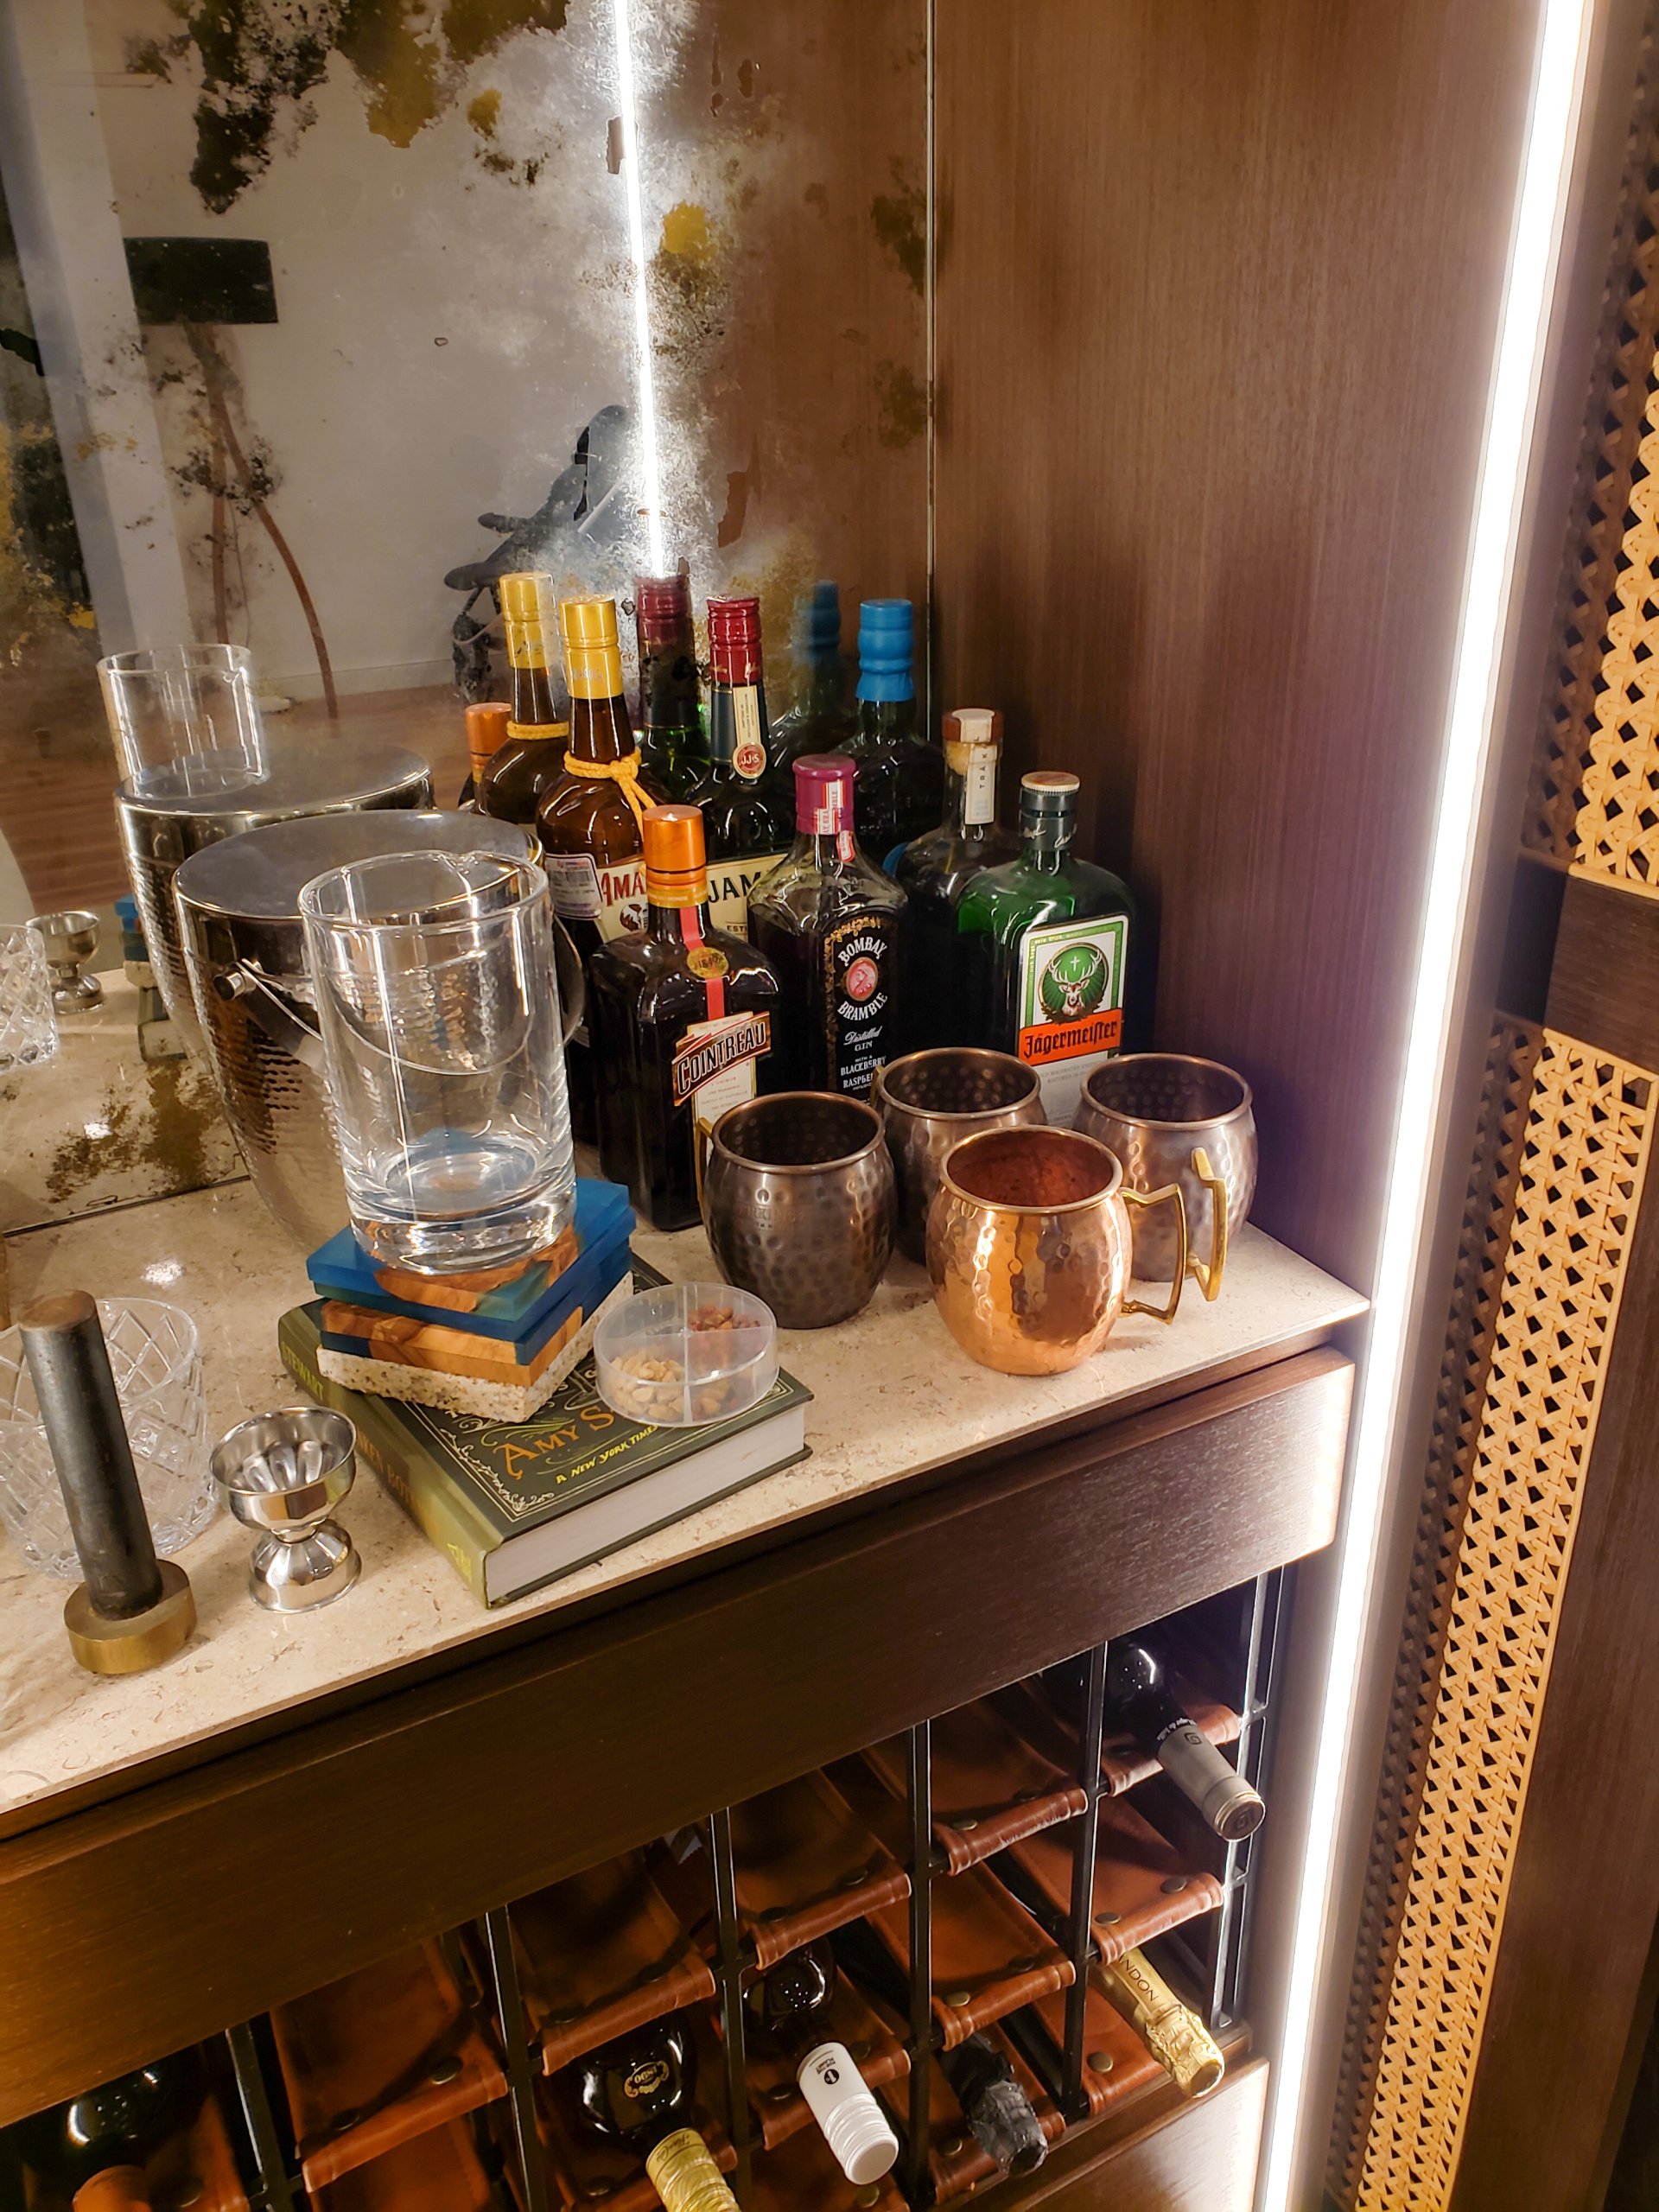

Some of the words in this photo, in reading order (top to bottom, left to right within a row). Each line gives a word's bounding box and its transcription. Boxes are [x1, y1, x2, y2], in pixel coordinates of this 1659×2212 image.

[837, 937, 887, 967] BOMBAY
[837, 992, 888, 1020] BRAMBLE
[677, 1021, 766, 1096] COINTREAU
[854, 1040, 873, 1052] GIN
[840, 1055, 887, 1077] BLACKBERRY
[556, 1473, 568, 1484] A
[571, 1456, 596, 1478] NEW
[598, 1441, 632, 1464] YORK
